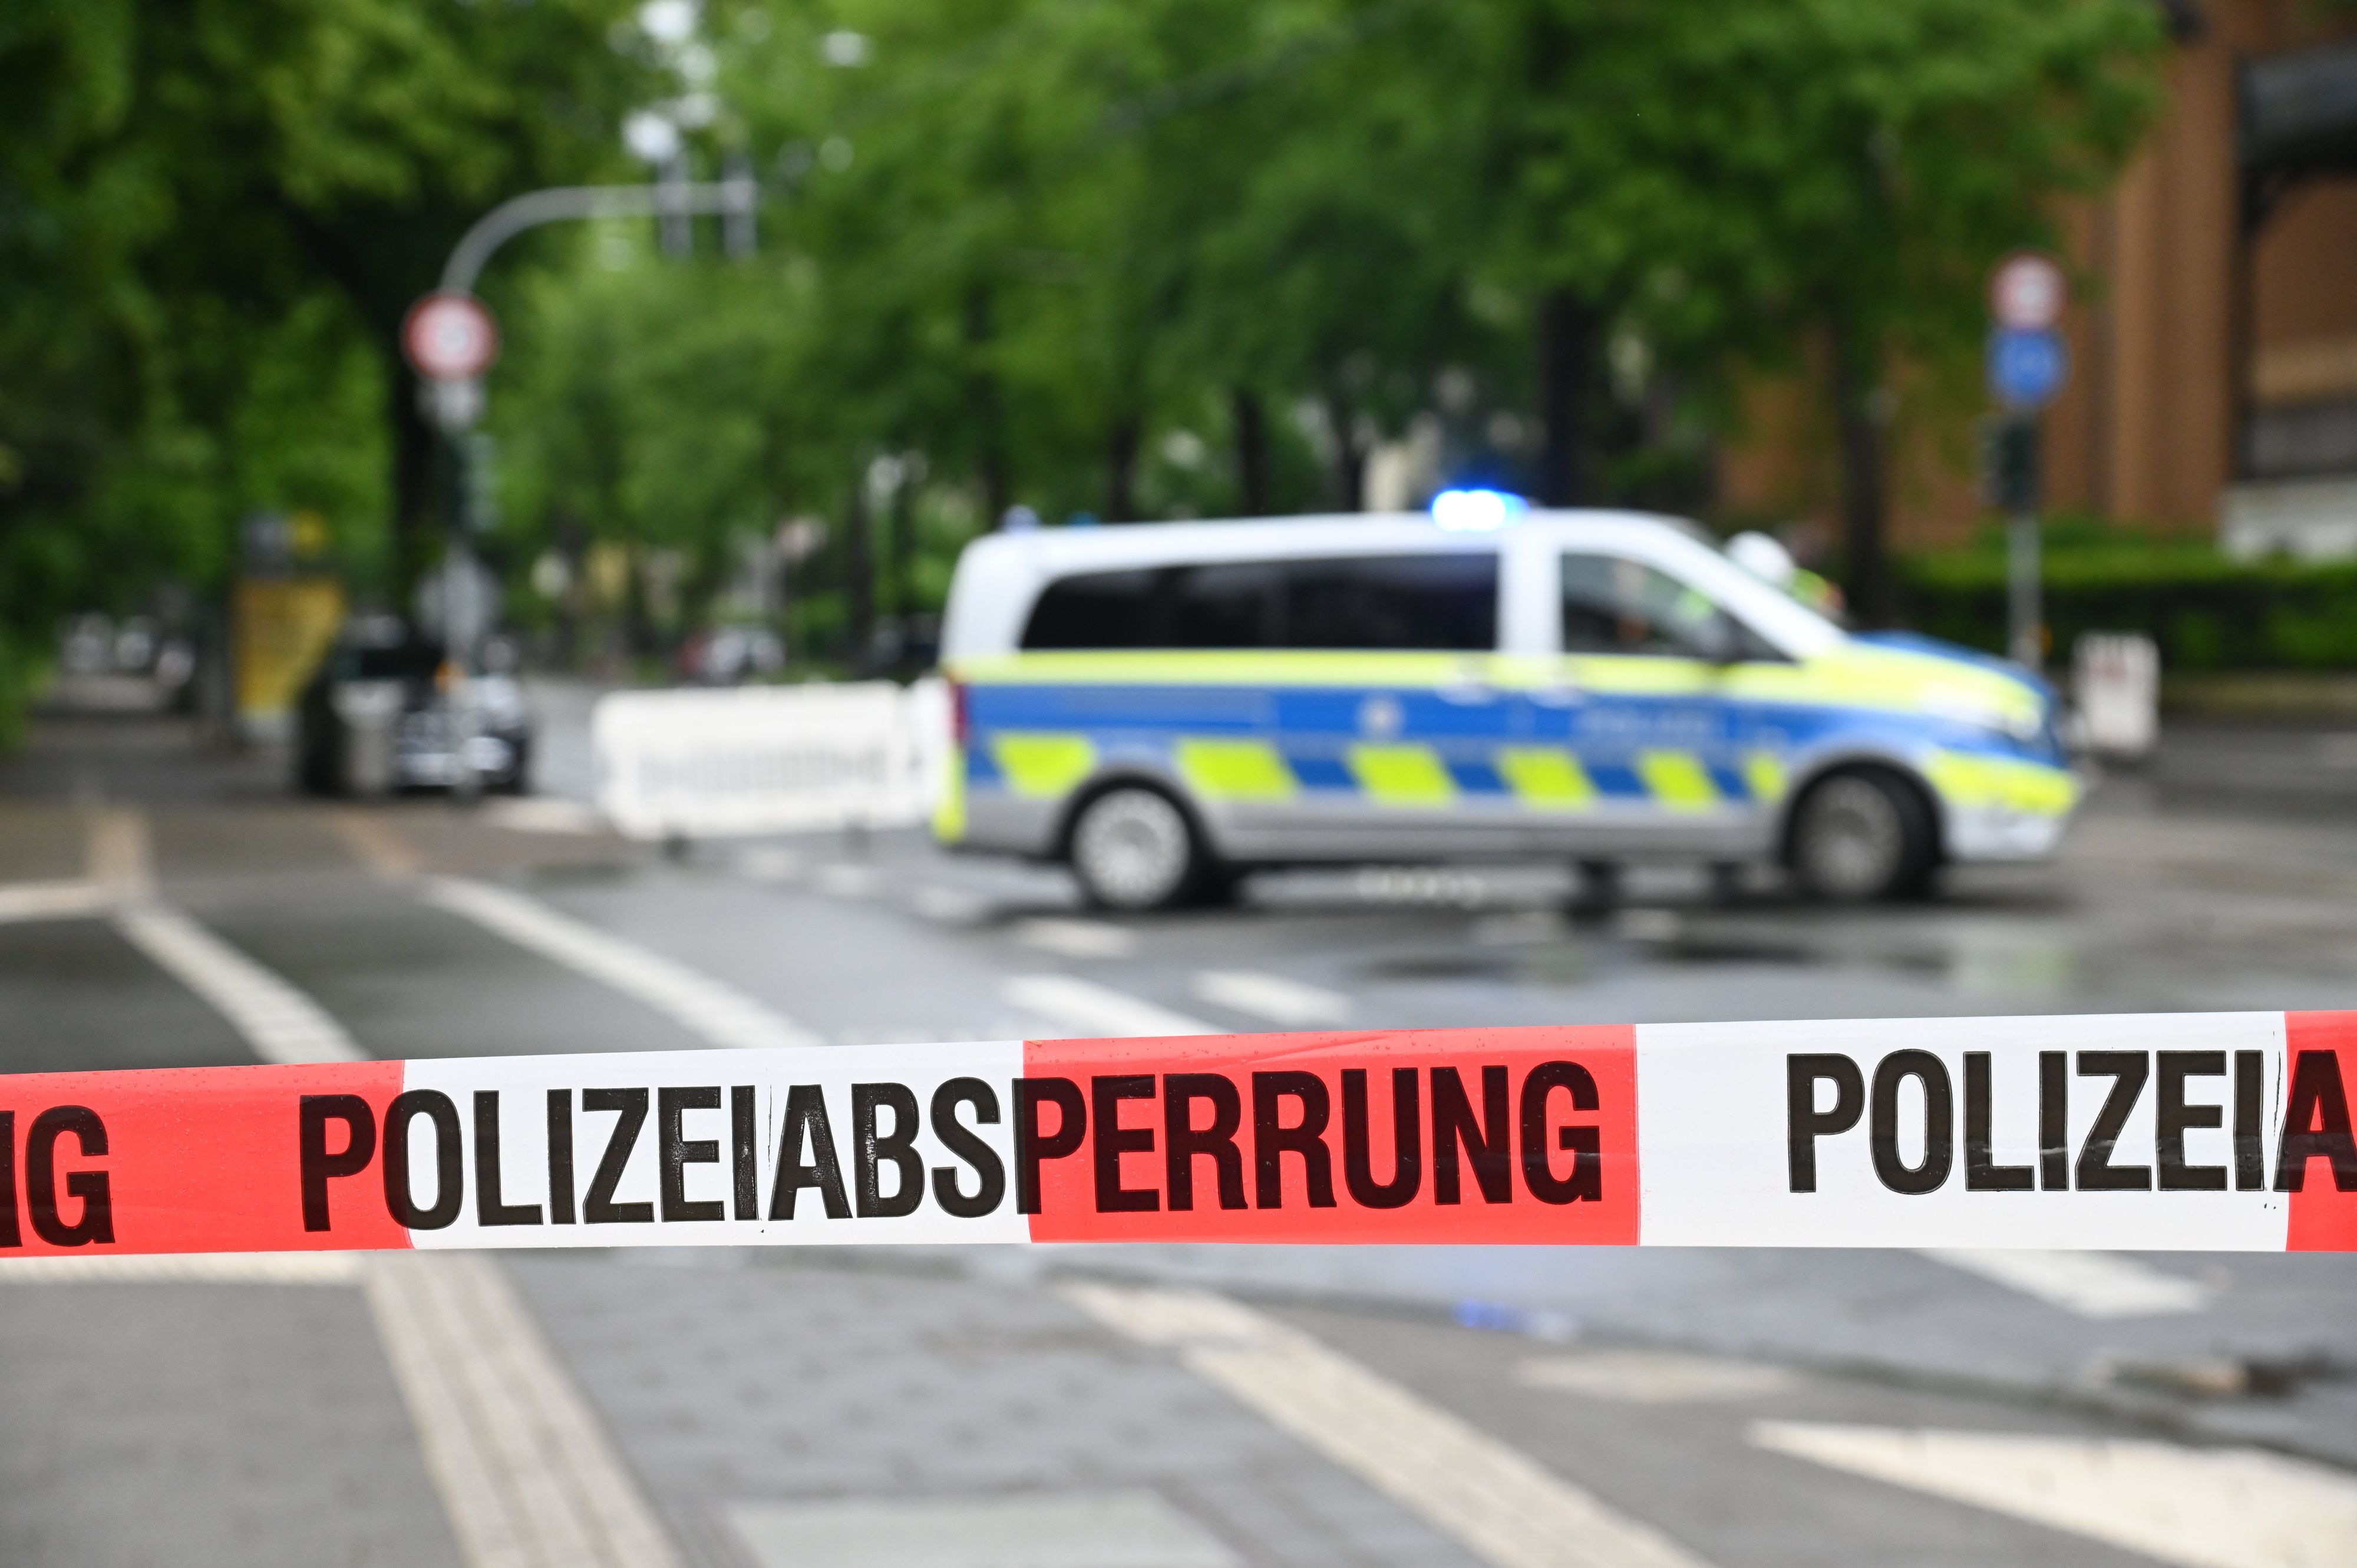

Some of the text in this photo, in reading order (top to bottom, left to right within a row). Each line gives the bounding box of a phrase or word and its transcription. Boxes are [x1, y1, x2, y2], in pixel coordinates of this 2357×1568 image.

[0, 1048, 2357, 1248] G POLIZEIABSPERRUNG POLIZEIA
